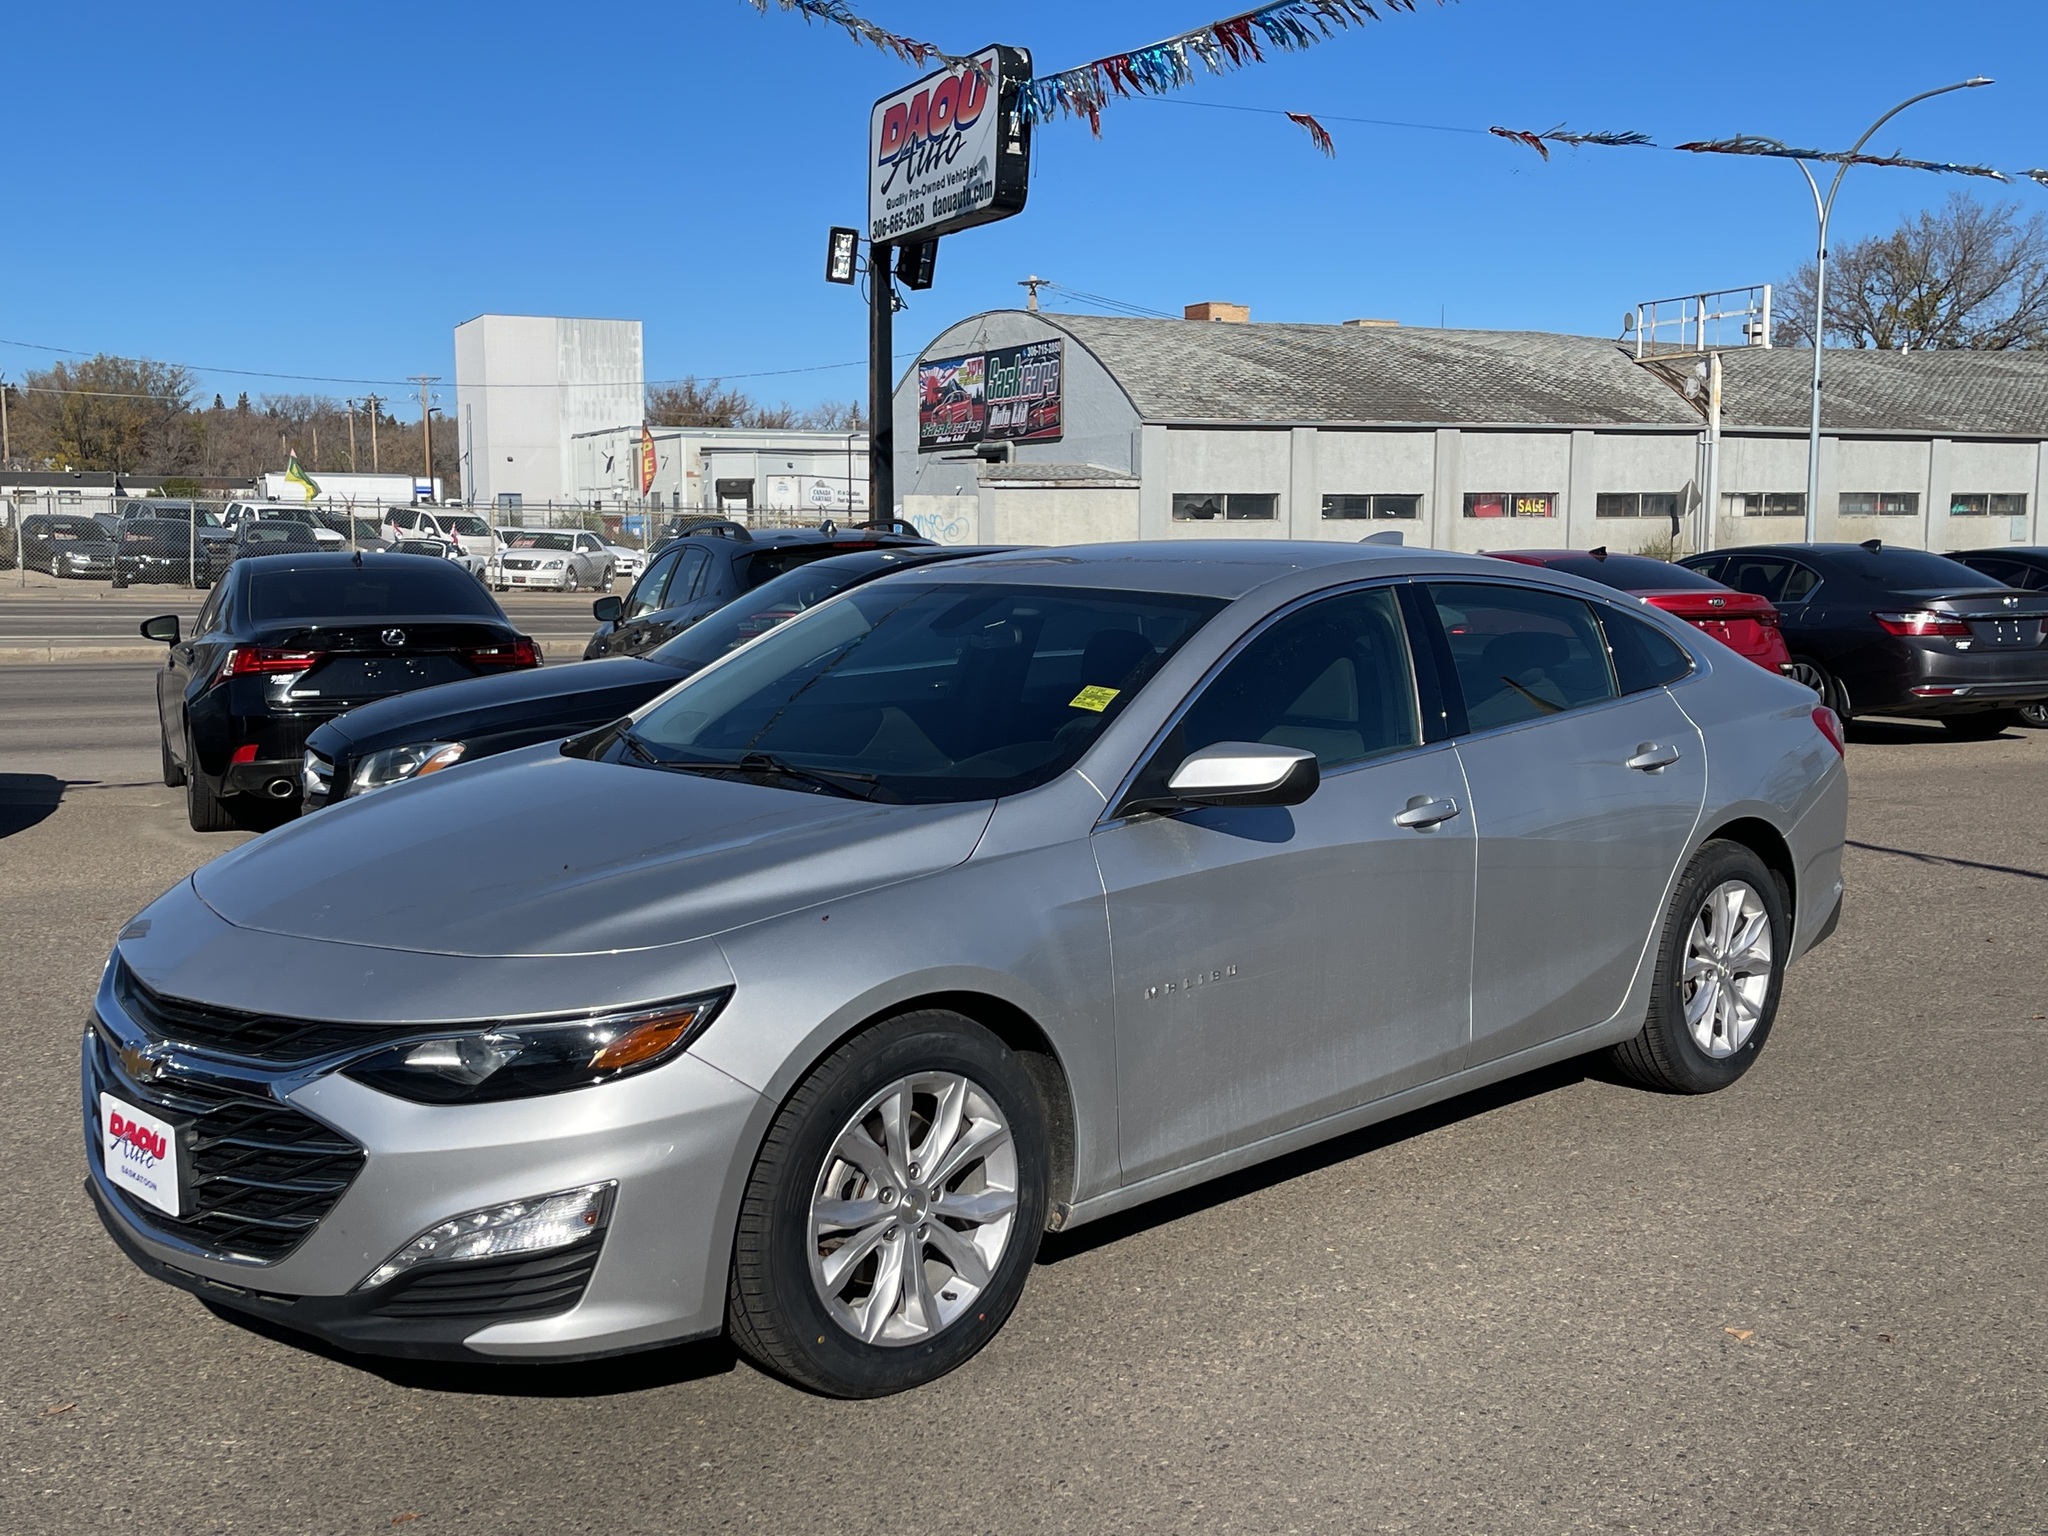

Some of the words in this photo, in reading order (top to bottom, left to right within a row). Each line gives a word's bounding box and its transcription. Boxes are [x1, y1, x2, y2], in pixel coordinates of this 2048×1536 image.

[878, 58, 993, 168] DAOU
[881, 127, 967, 195] Auto
[872, 203, 925, 240] 306-665-3268
[932, 179, 993, 218] daouauto.com
[886, 192, 908, 210] Quality
[909, 178, 946, 203] Pre-Owned
[946, 165, 978, 187] Vehicles
[987, 353, 1060, 405] Saskcars
[921, 419, 983, 438] Saskcars
[990, 404, 1012, 429] Auto
[1011, 401, 1029, 428] Ltd
[1518, 499, 1545, 513] SALE
[109, 1112, 167, 1160] DAOU
[110, 1131, 157, 1169] Auto
[121, 1165, 158, 1192] SASKATOON
